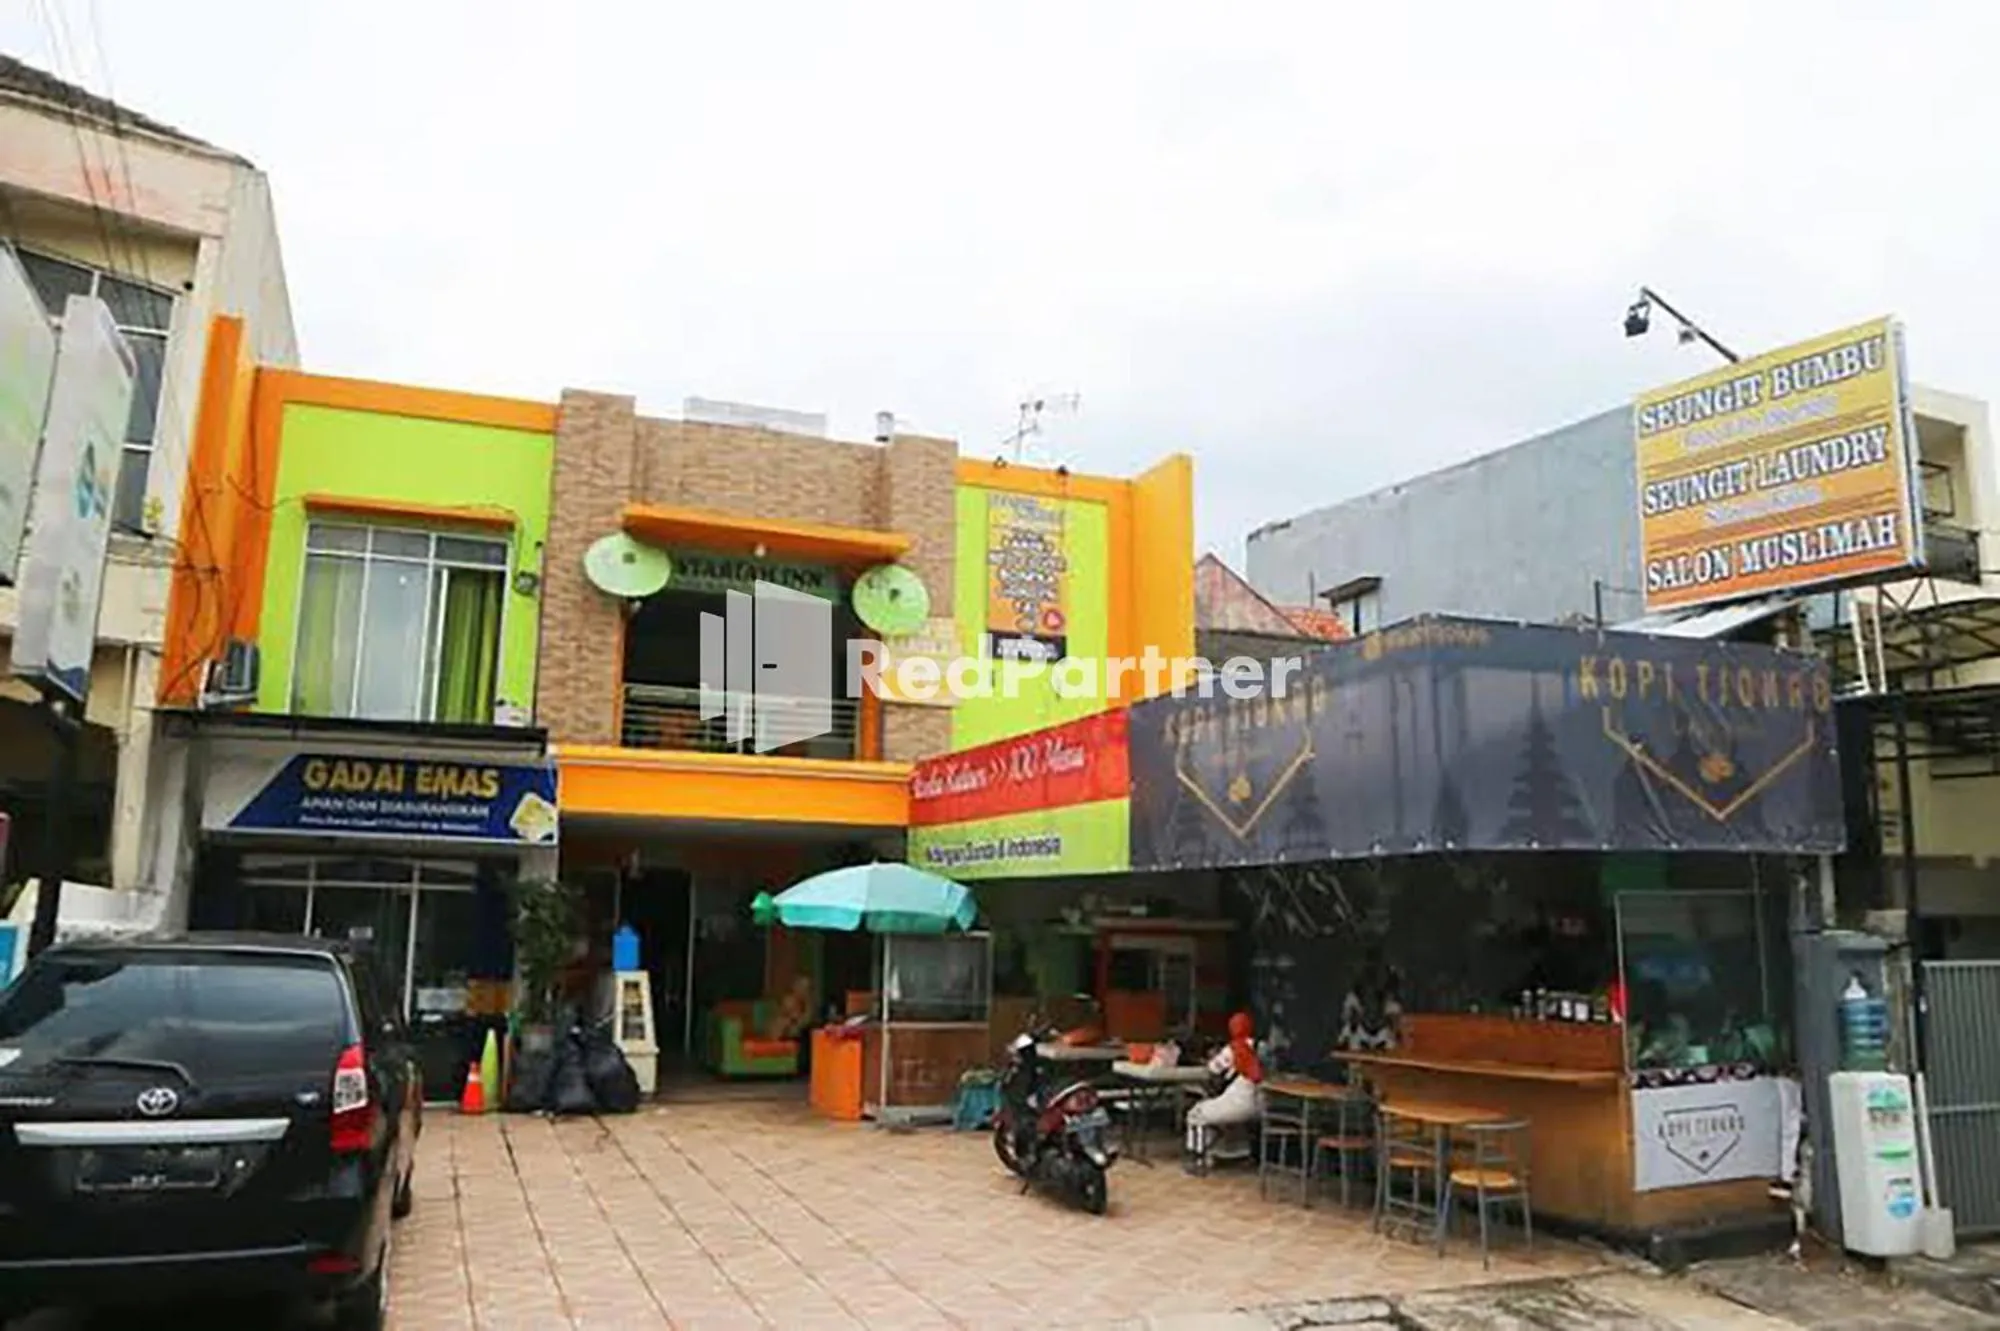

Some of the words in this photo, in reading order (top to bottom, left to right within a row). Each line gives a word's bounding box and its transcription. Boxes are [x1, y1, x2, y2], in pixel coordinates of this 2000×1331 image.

[1639, 371, 1766, 435] SEUNGIT
[1769, 335, 1886, 398] BUMBU
[1643, 460, 1751, 516] SEUNGIT
[1757, 425, 1889, 488] LAUNDRY
[1646, 546, 1734, 592] SALON
[1738, 512, 1898, 575] MUSLIMAH
[1580, 655, 1675, 702] KOPI
[303, 759, 403, 791] GADAI
[415, 765, 499, 798] EMAS
